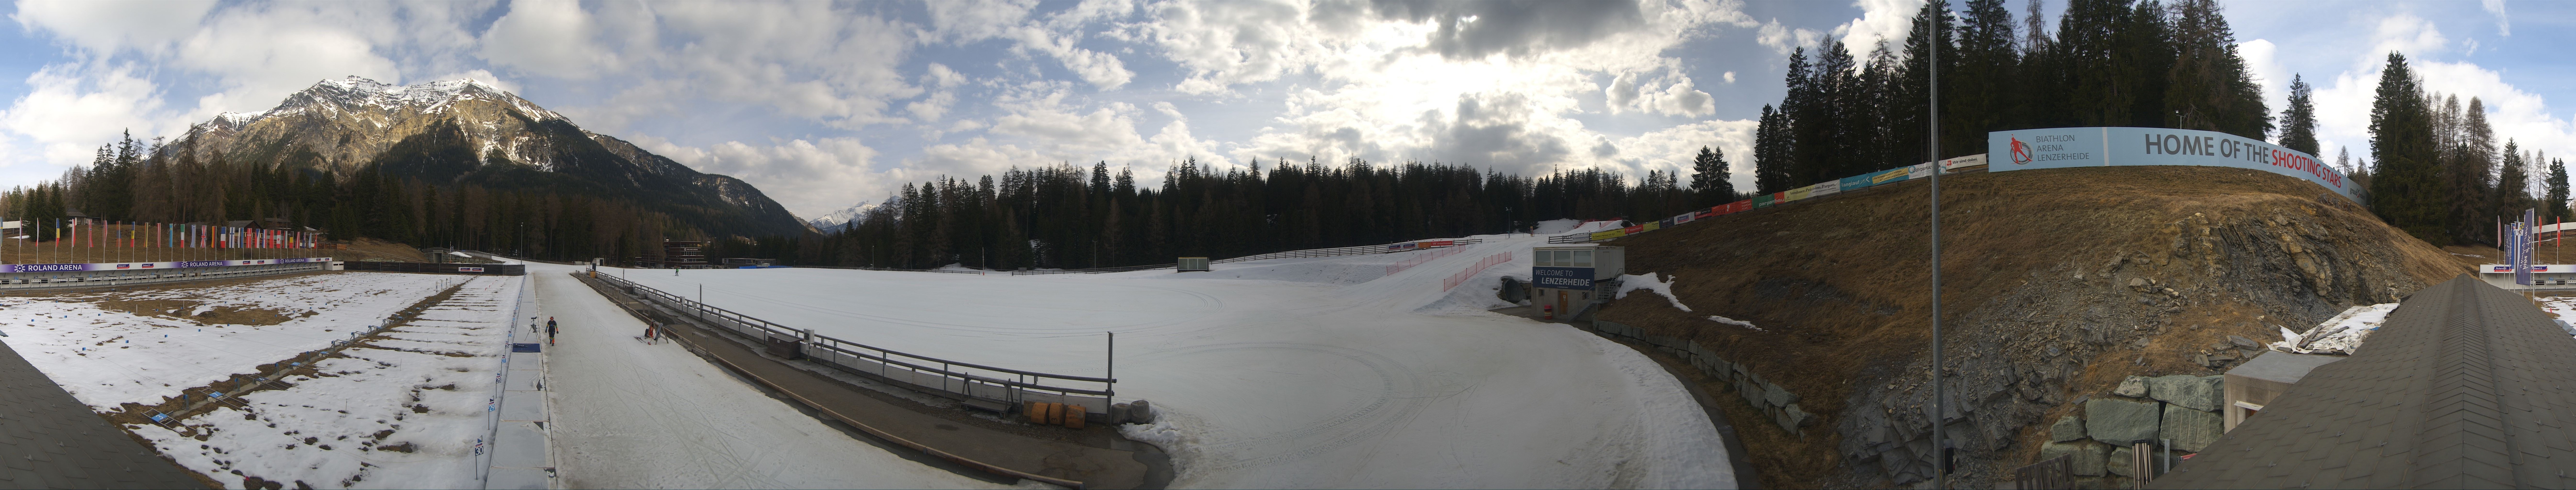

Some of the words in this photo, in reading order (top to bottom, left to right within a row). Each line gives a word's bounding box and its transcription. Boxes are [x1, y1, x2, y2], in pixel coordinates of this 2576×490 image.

[2038, 153, 2089, 161] LENZERHEIDE
[2145, 134, 2214, 156] HOME
[2221, 138, 2240, 159] OF
[2244, 143, 2269, 164] THE
[2272, 149, 2321, 177] SHOOTING
[2323, 167, 2341, 188] STARS
[1759, 198, 1784, 207] parpanbau
[1541, 277, 1590, 286] LENZERHEIDE
[476, 446, 483, 455] 30
